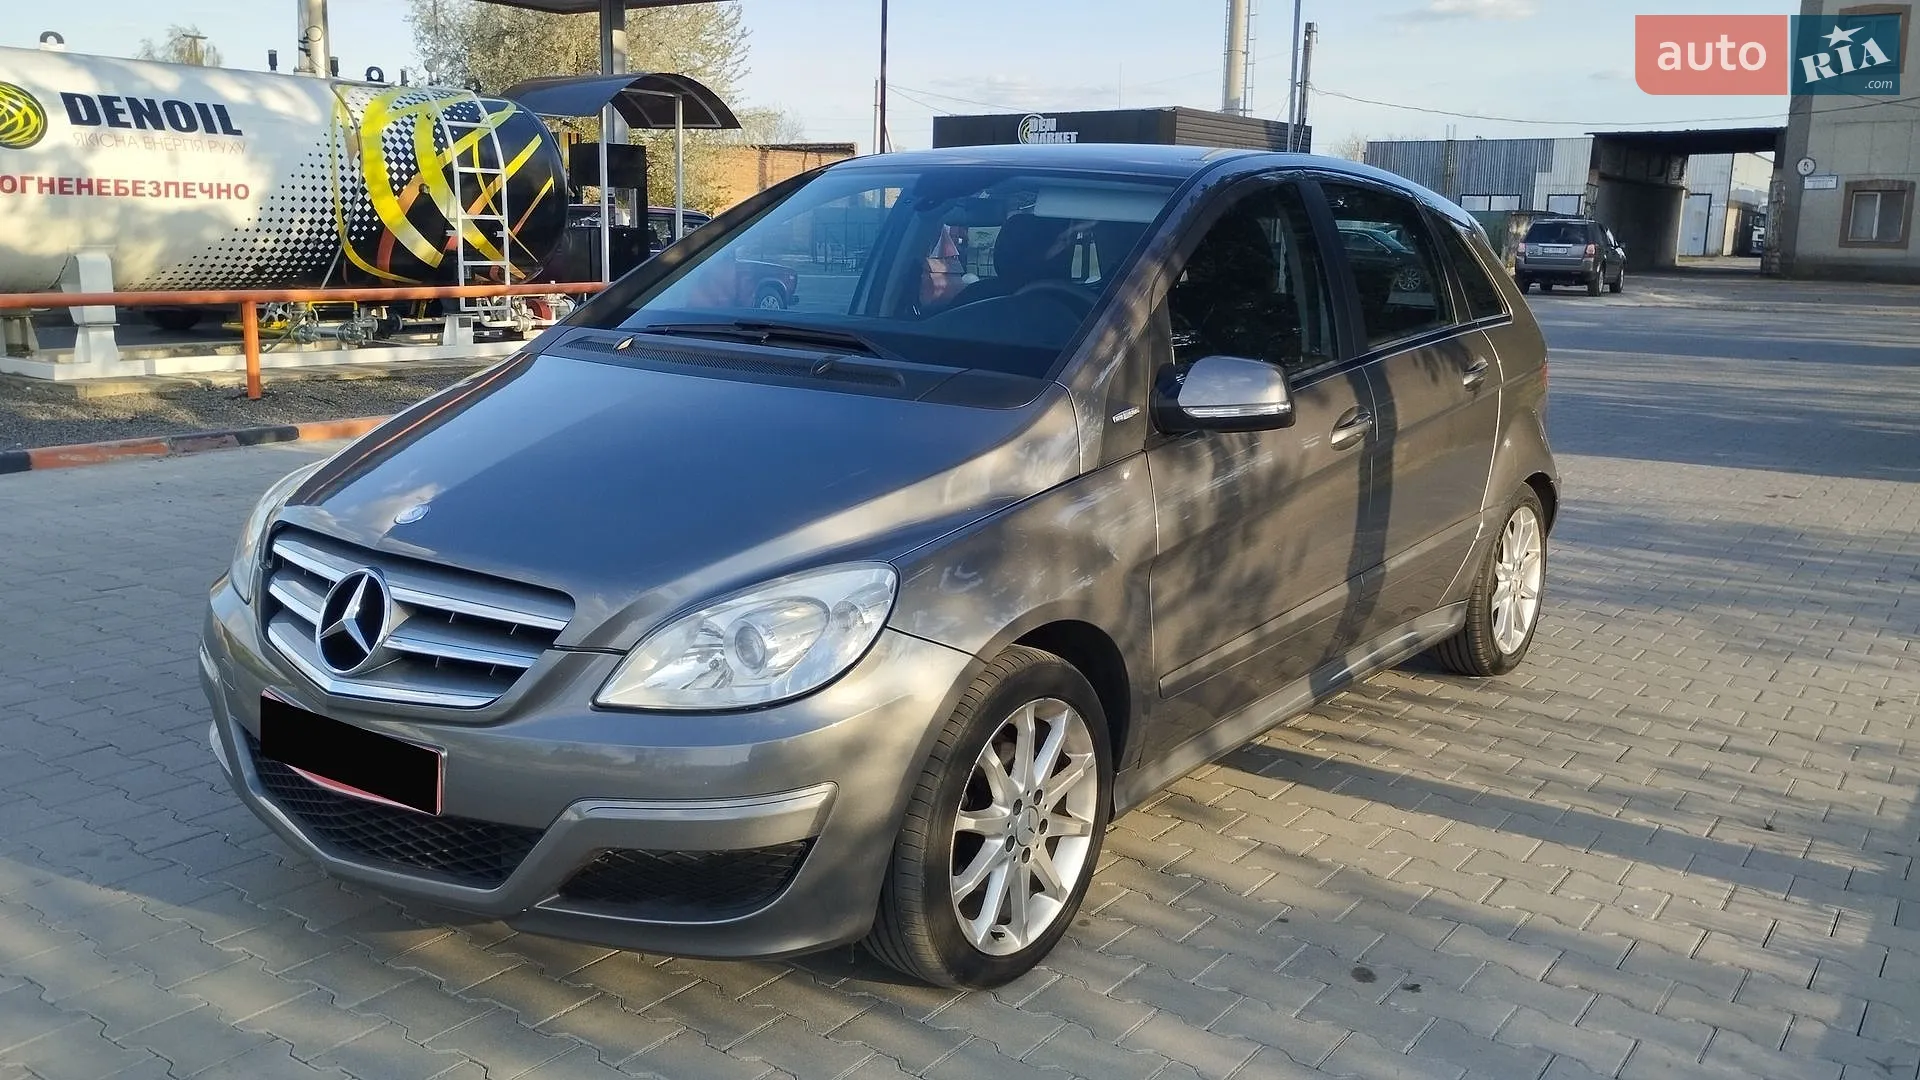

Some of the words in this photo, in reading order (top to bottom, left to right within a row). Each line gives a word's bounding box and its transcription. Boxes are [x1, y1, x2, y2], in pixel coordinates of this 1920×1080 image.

[60, 91, 243, 136] DENOIL
[208, 139, 246, 154] РУХУ
[0, 174, 250, 200] ОГНЕНЕБЕЗПЕЧНО
